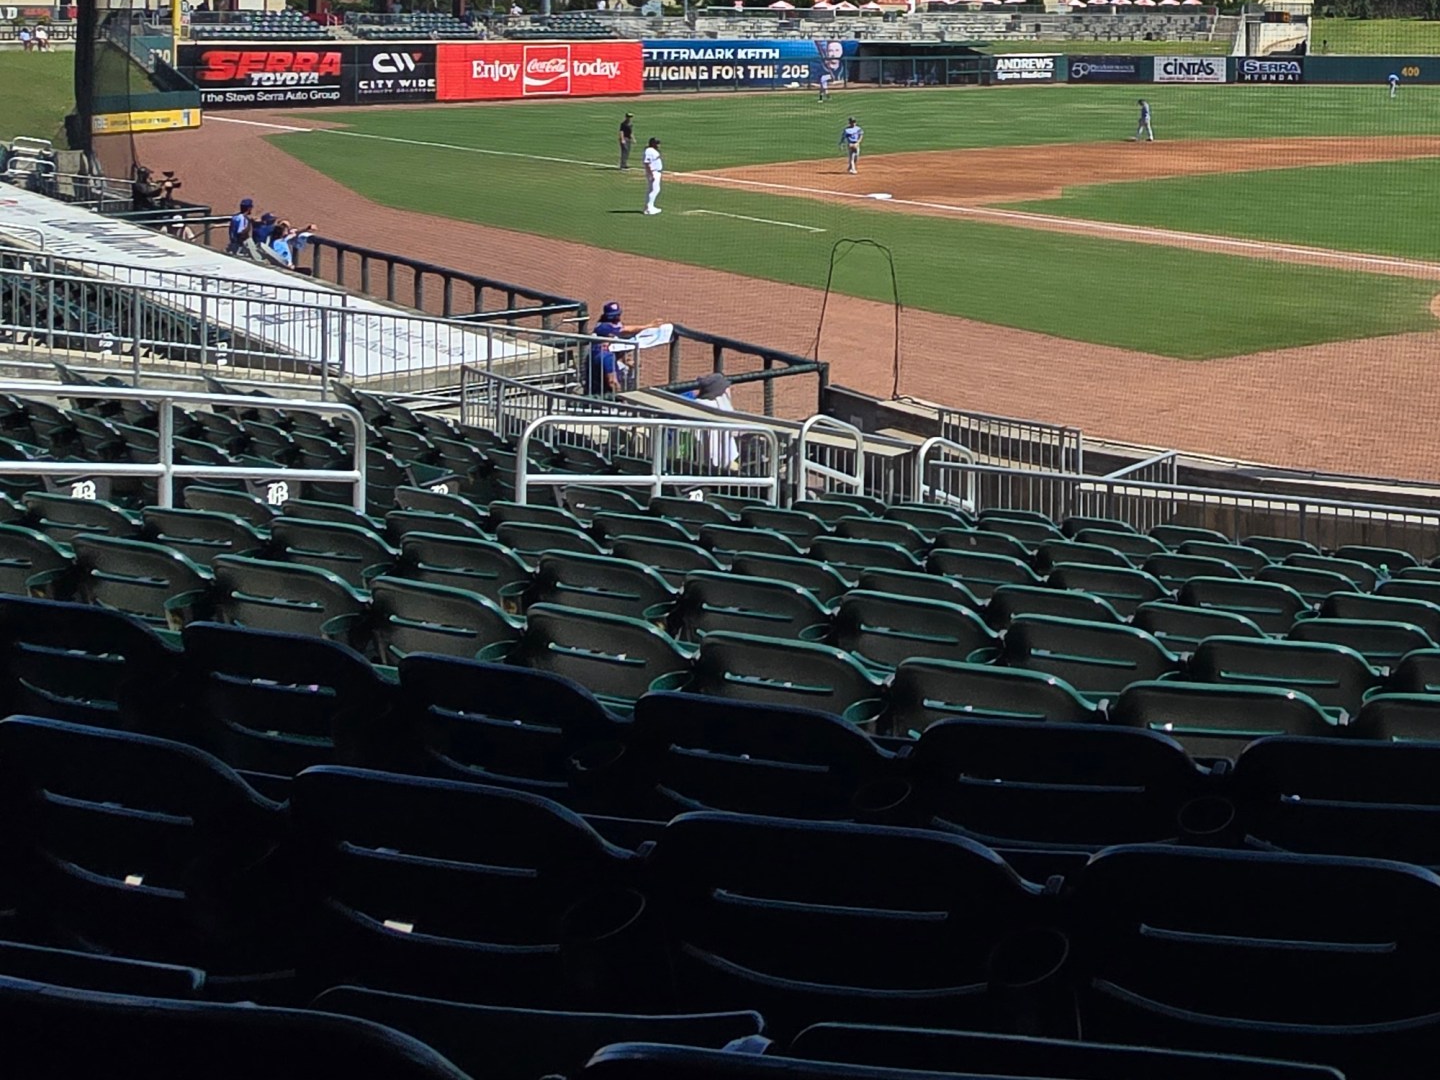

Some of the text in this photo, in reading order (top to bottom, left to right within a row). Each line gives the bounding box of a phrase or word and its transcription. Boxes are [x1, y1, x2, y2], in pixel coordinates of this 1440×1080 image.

[198, 50, 342, 81] SERRA
[472, 59, 520, 83] Enjoy
[572, 58, 621, 78] today.
[996, 58, 1054, 70] ANDREWS
[1244, 60, 1301, 74] SERRA
[249, 71, 320, 86] TOYOTA
[711, 65, 744, 80] FOR
[781, 64, 810, 79] 205
[1401, 66, 1420, 77] 400
[358, 78, 436, 90] CITY WIDE
[207, 93, 225, 103] the
[225, 91, 256, 103] Steve
[256, 91, 285, 102] Serra
[285, 90, 308, 101] Auto
[309, 90, 341, 101] Group
